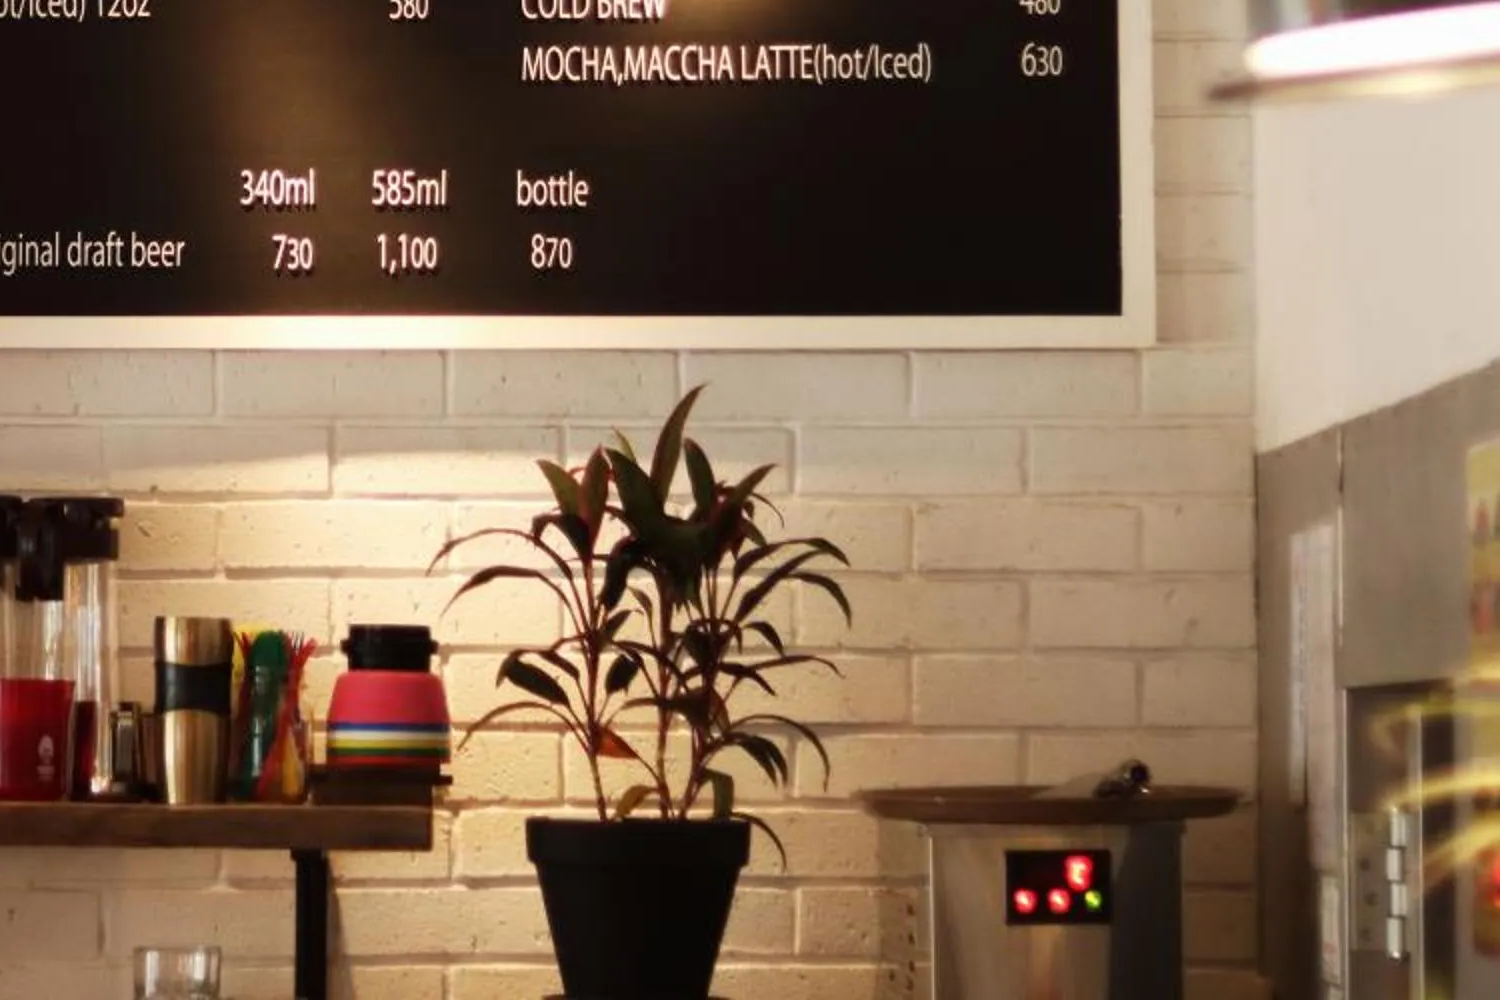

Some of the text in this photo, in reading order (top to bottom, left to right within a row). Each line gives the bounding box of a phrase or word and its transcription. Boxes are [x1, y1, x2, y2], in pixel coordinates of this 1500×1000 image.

[740, 44, 932, 83] LATTE(hot/Iced)
[1021, 44, 1063, 78] 630
[240, 169, 316, 208] 340ml
[371, 169, 447, 208] 585ml
[516, 169, 589, 208] bottle
[66, 231, 123, 267] draft
[131, 231, 185, 267] beer
[272, 233, 313, 273] 730
[377, 234, 437, 277] 1,100
[530, 234, 572, 270] 870
